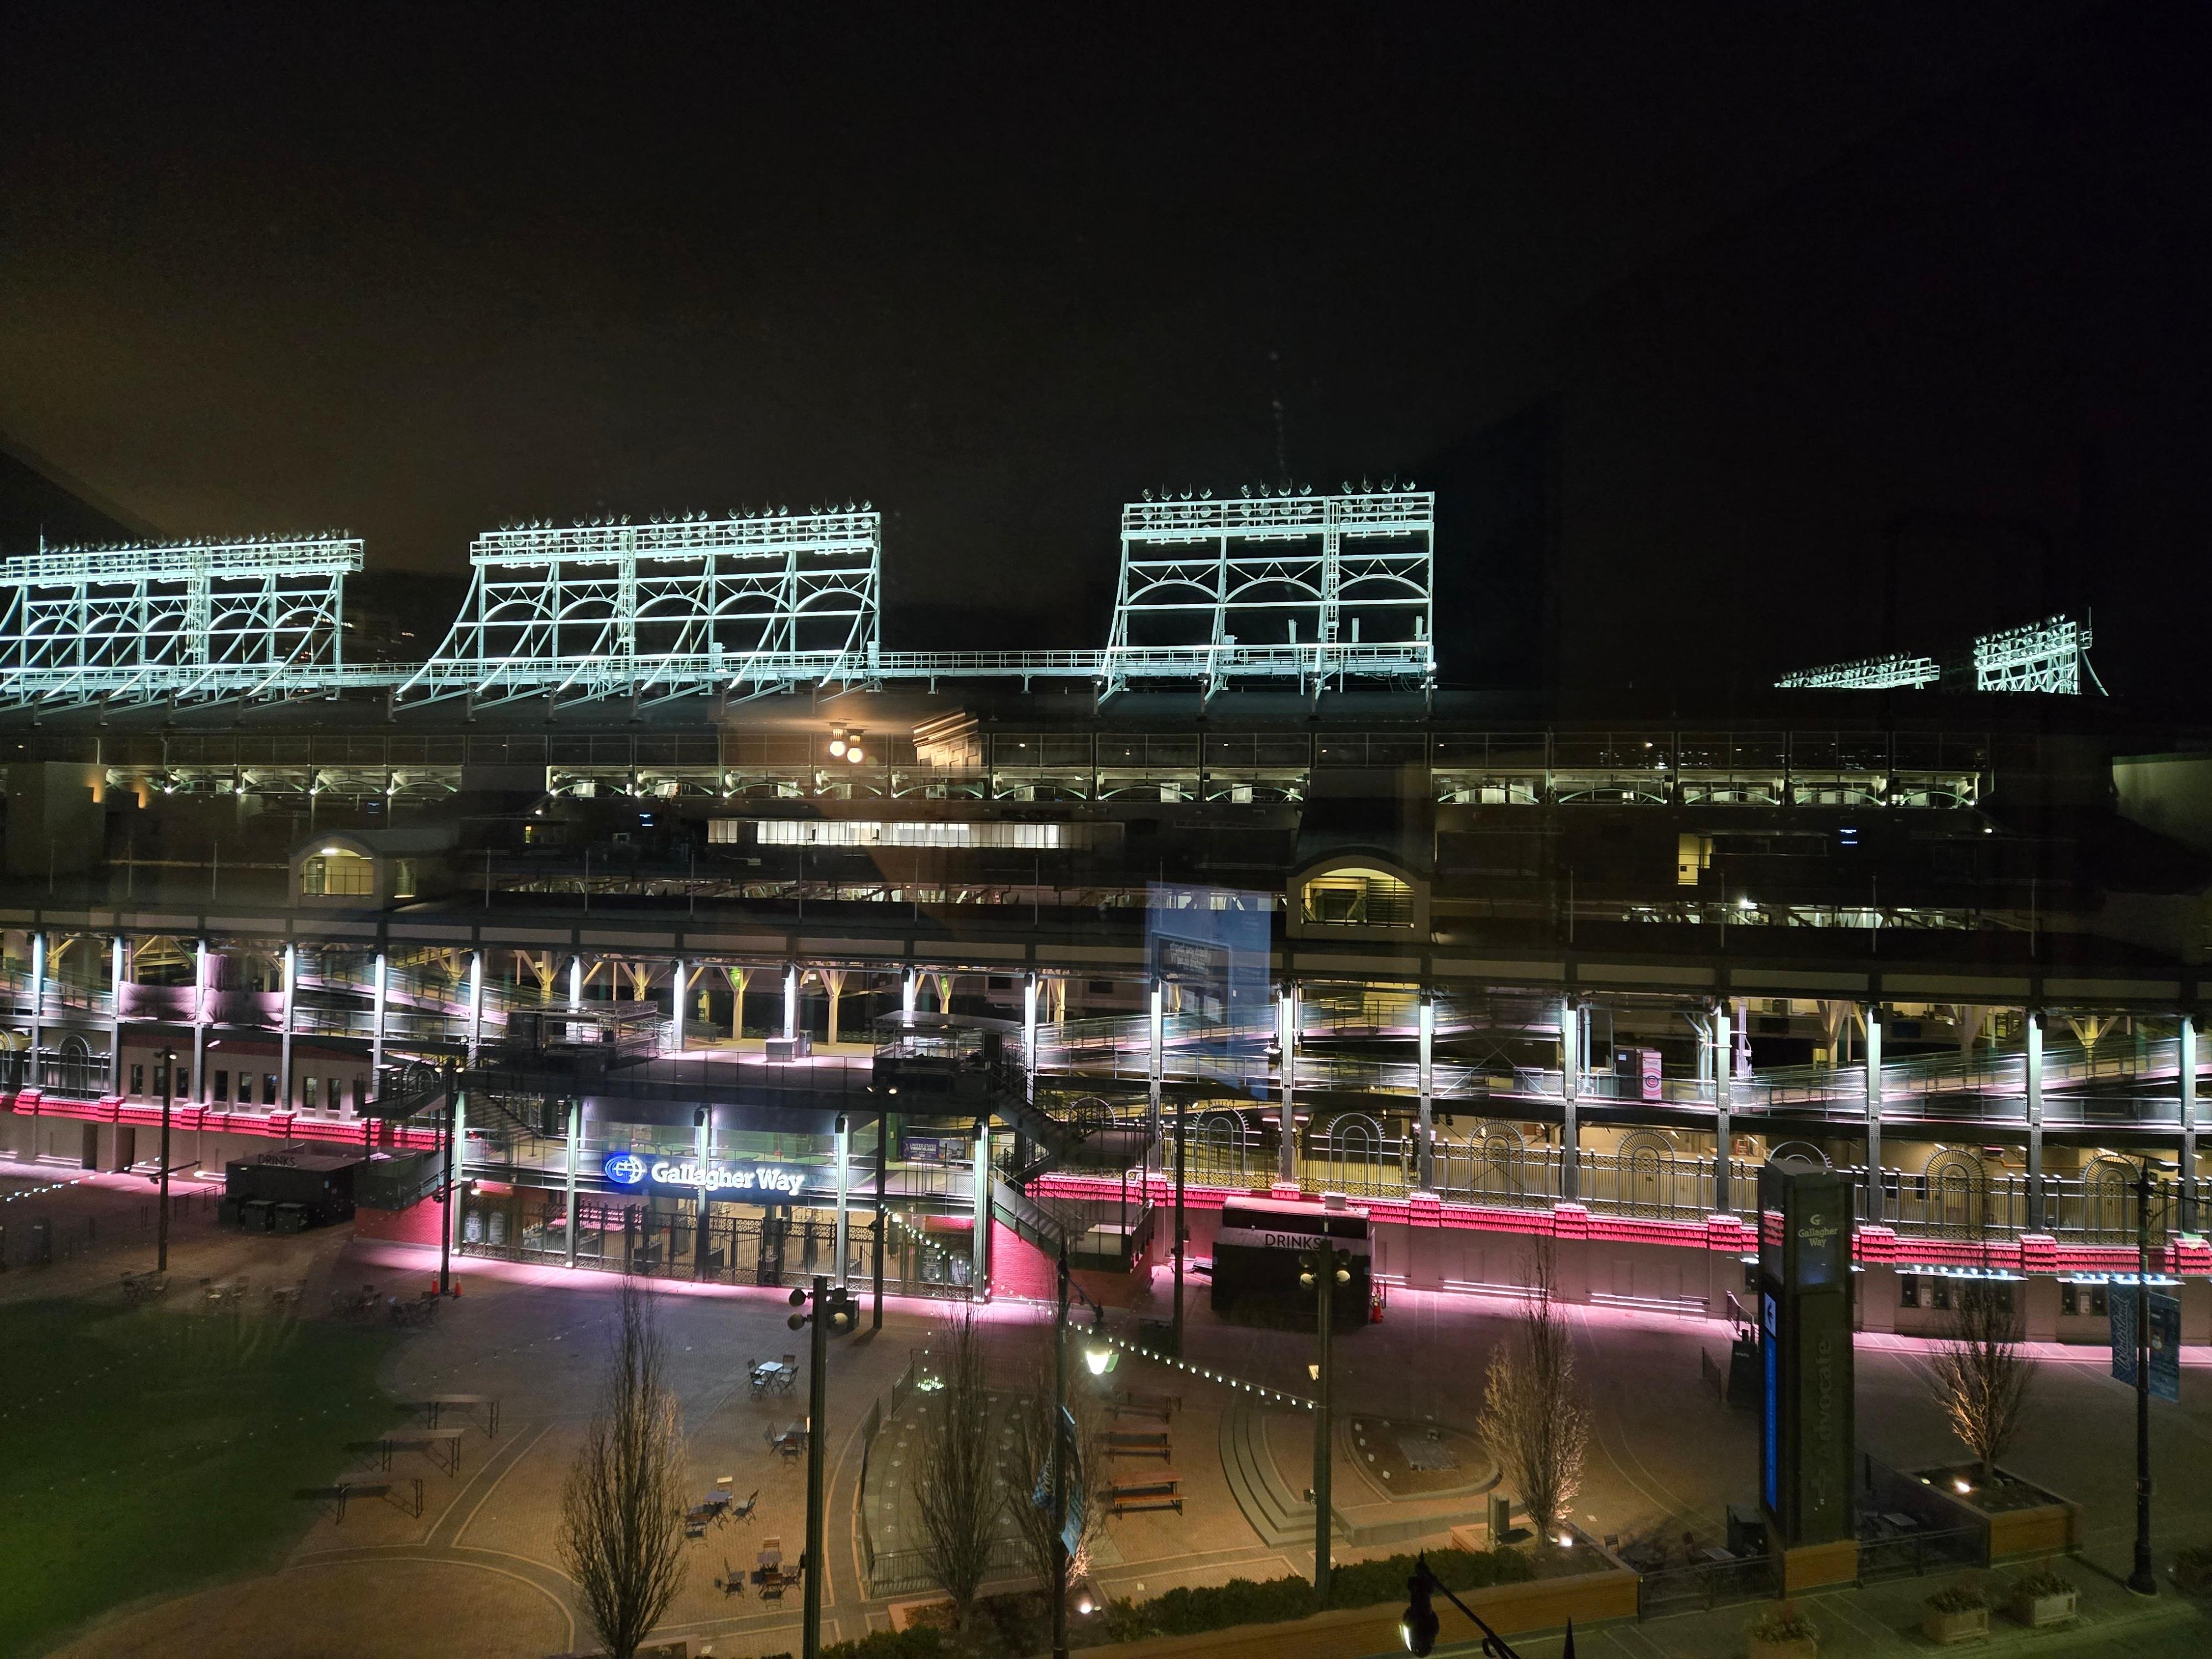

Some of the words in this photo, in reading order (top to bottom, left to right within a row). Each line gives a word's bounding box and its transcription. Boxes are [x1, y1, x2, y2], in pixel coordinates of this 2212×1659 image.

[258, 1154, 296, 1166] DRINKS
[651, 1162, 755, 1191] Gallagher
[756, 1167, 805, 1196] Way
[1798, 1228, 1838, 1238] Gallagher
[1265, 1233, 1321, 1250] DRINKS
[1808, 1238, 1827, 1248] Way
[1813, 1339, 1832, 1459] Advocate
